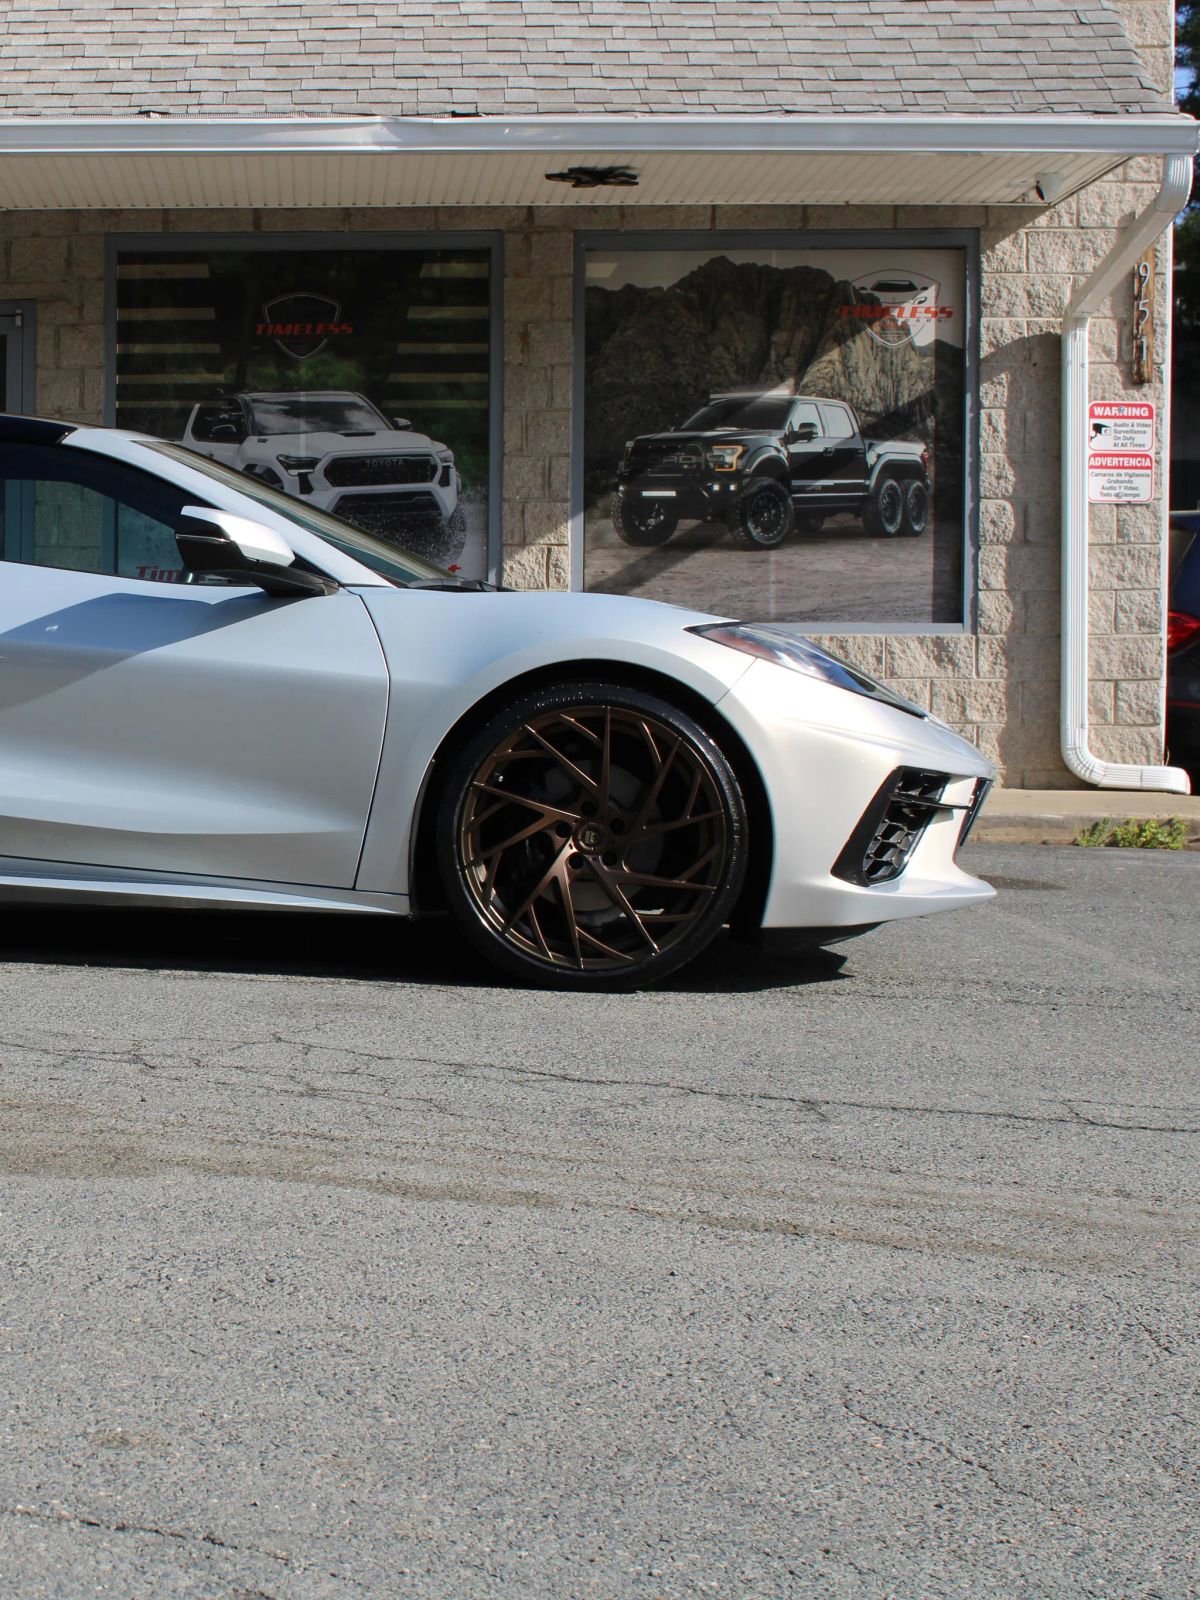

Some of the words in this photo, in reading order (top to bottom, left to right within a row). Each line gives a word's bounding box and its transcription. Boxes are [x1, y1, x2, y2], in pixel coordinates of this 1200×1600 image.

[839, 304, 954, 318] TIMELESS
[1138, 262, 1150, 361] 951
[255, 322, 353, 336] TIMELESS
[1093, 406, 1149, 416] WARNING
[1089, 457, 1151, 466] ADVERTENCIA
